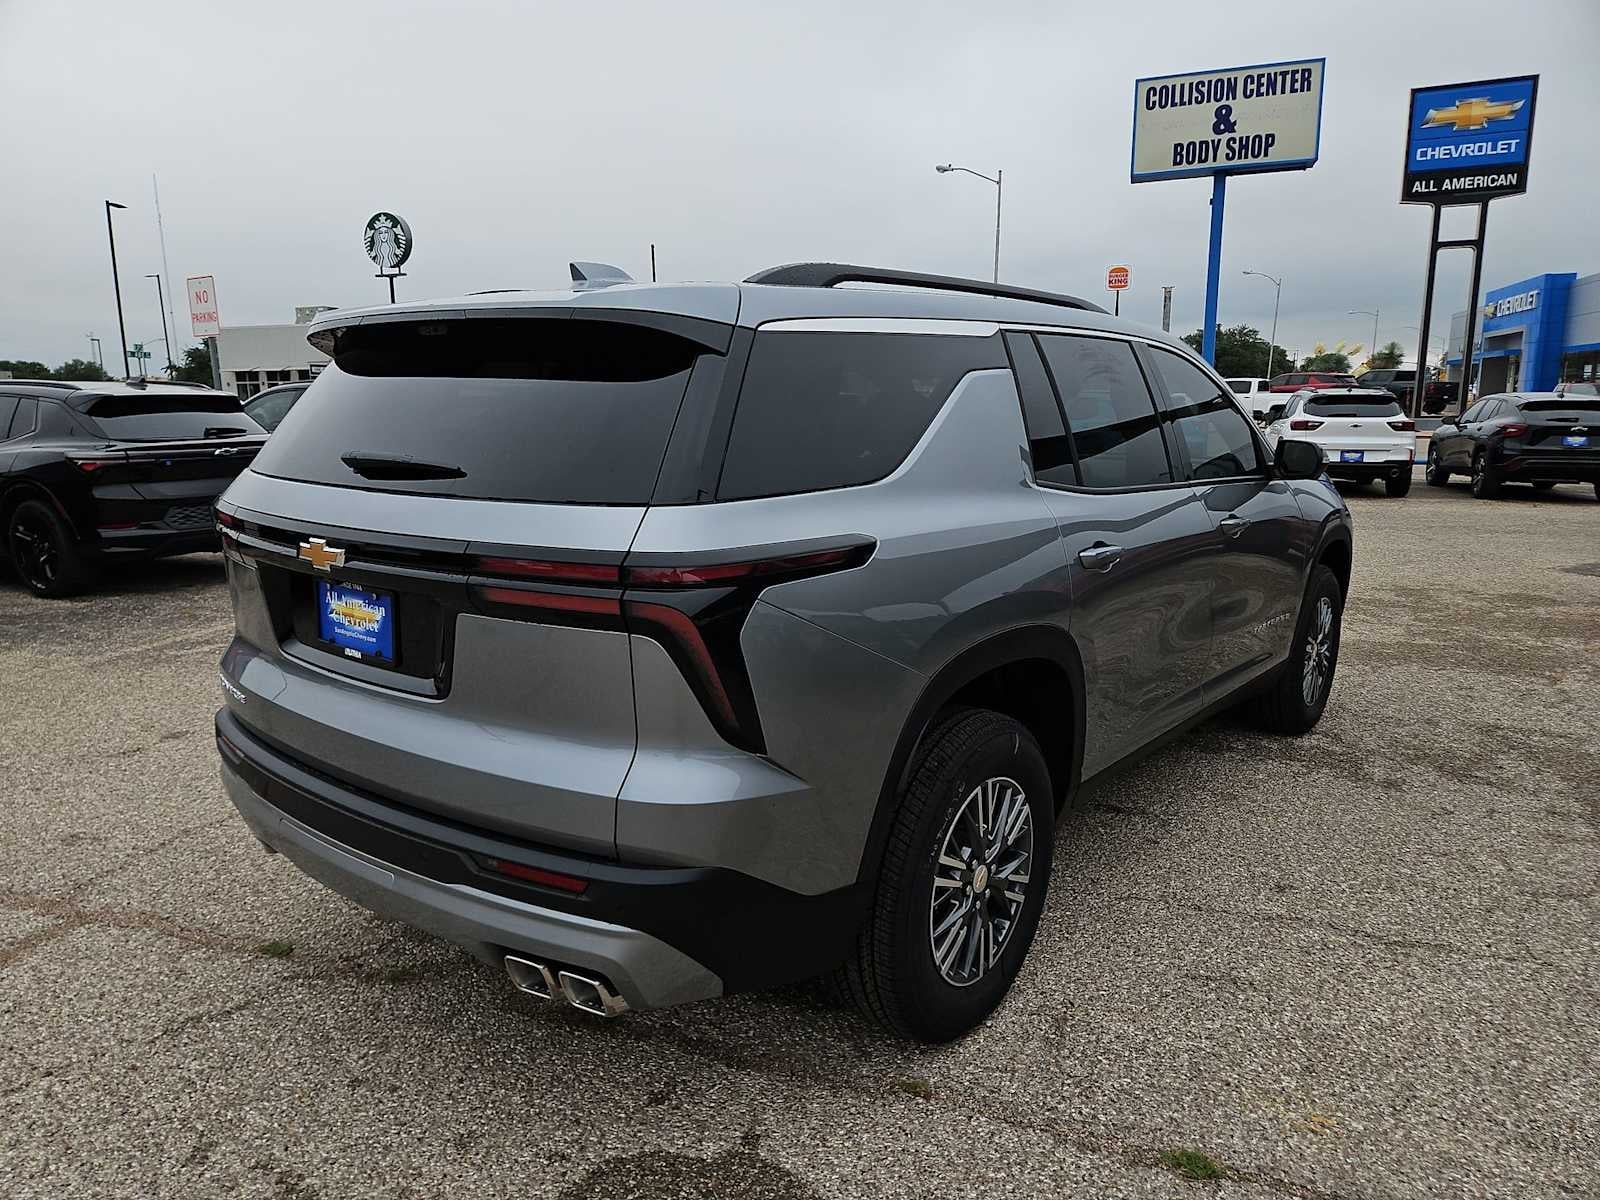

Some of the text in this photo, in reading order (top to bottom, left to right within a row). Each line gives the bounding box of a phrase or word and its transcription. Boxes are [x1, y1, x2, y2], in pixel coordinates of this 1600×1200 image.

[1145, 68, 1313, 111] COLLISION CENTER
[1212, 104, 1237, 135] &
[1172, 133, 1276, 167] BODY SHOP
[1416, 139, 1520, 161] CHEVROLET
[1412, 173, 1518, 193] ALL AMERICAN
[195, 290, 209, 304] NO
[1496, 289, 1540, 317] CHEVROLET
[192, 312, 217, 323] PARKING
[325, 591, 386, 617] All American
[332, 609, 379, 633] Chevrolet
